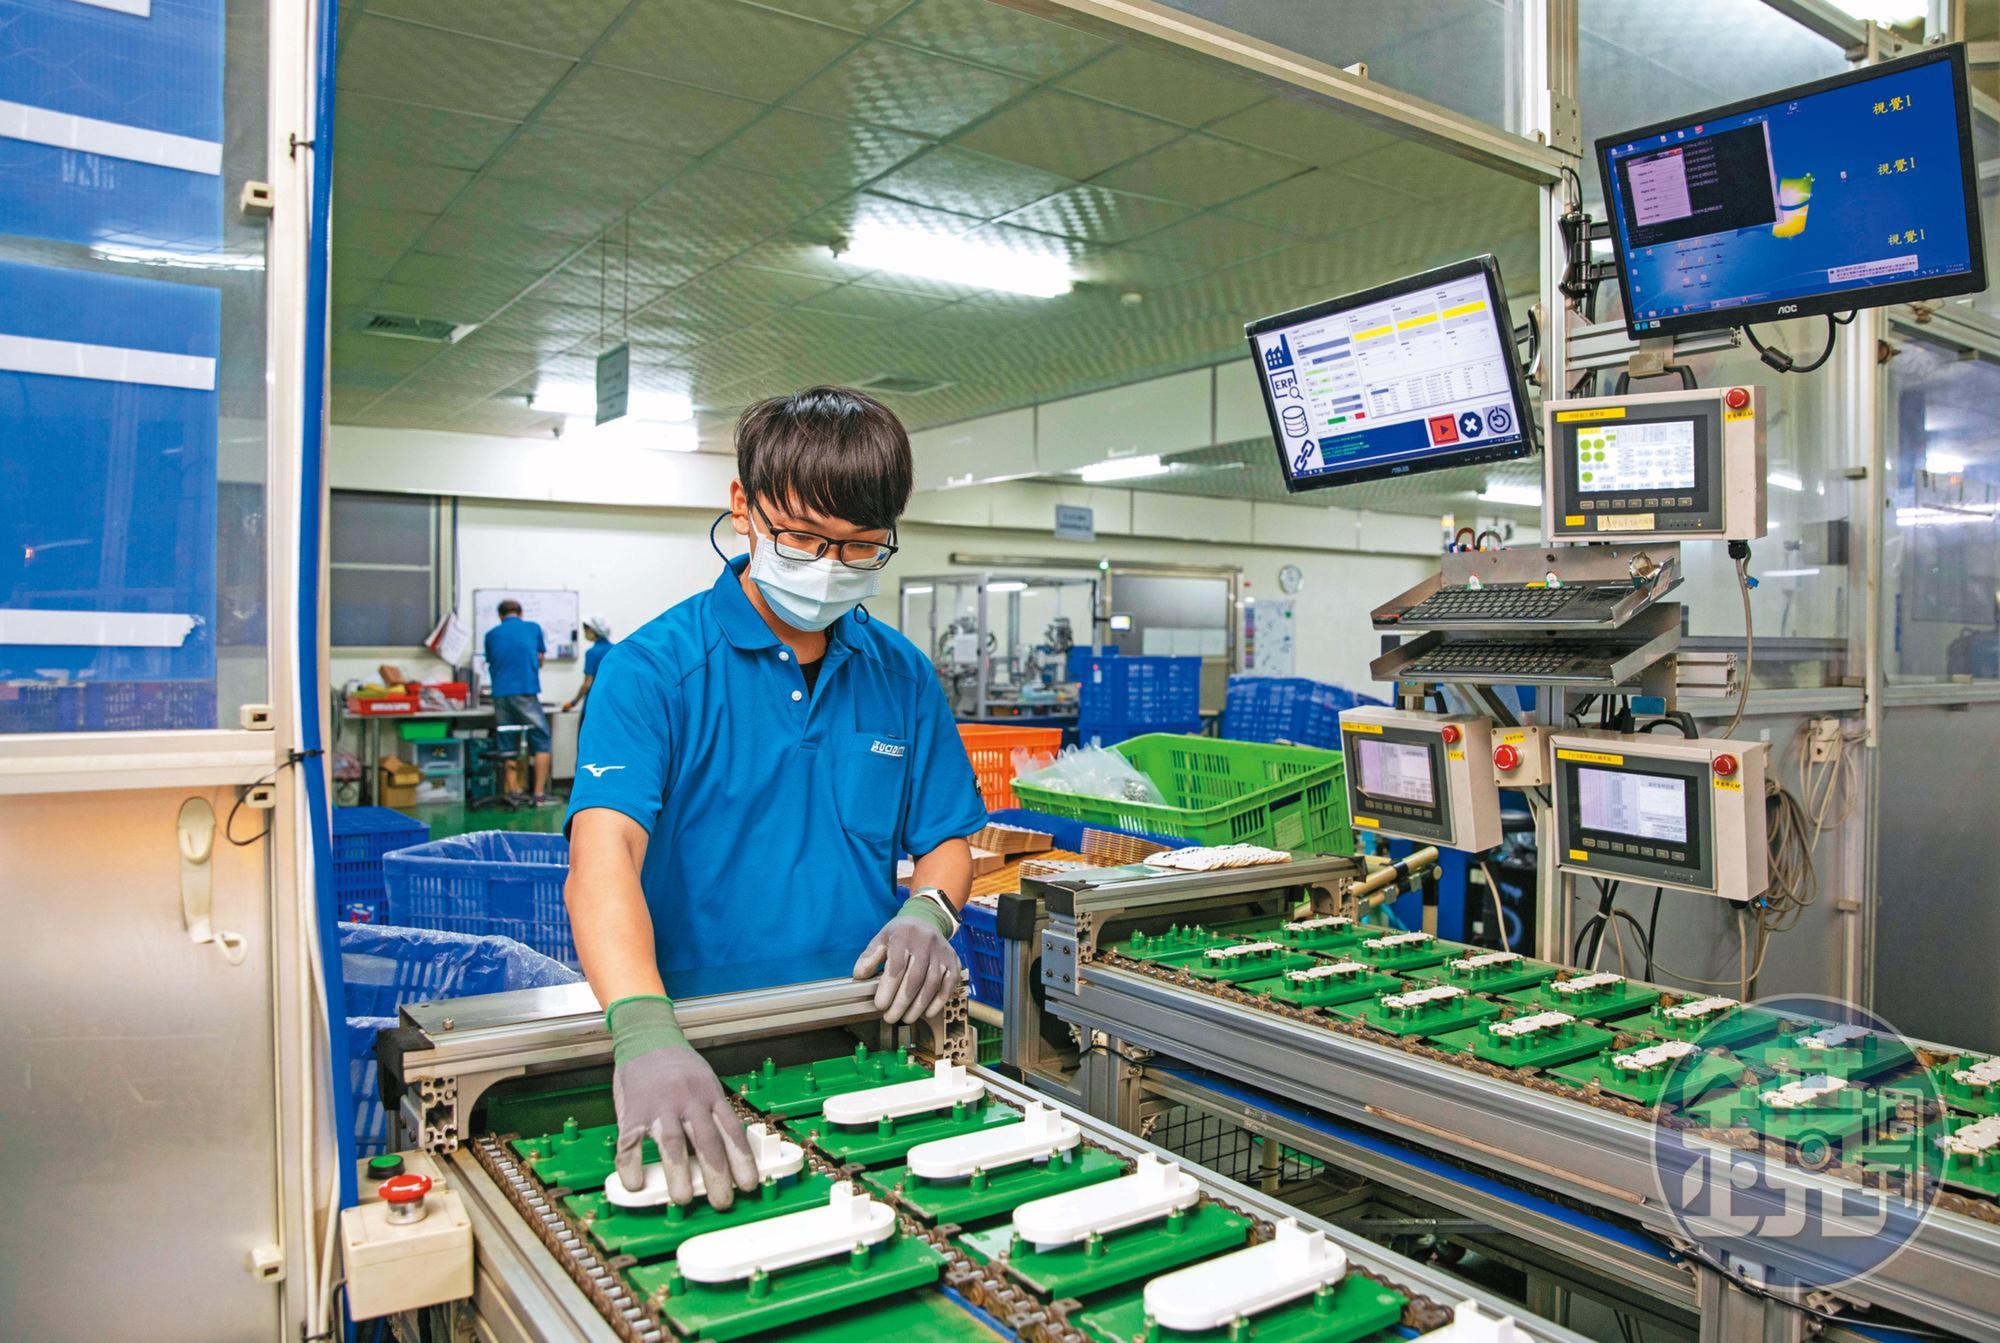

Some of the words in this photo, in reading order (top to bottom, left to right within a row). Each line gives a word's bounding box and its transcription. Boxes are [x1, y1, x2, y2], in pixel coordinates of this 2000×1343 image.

[1872, 95, 1912, 115] 視覺1
[1876, 156, 1915, 176] 視覺1
[1887, 229, 1925, 246] 視覺1
[1778, 304, 1798, 315] AOC
[1274, 377, 1294, 390] ERP
